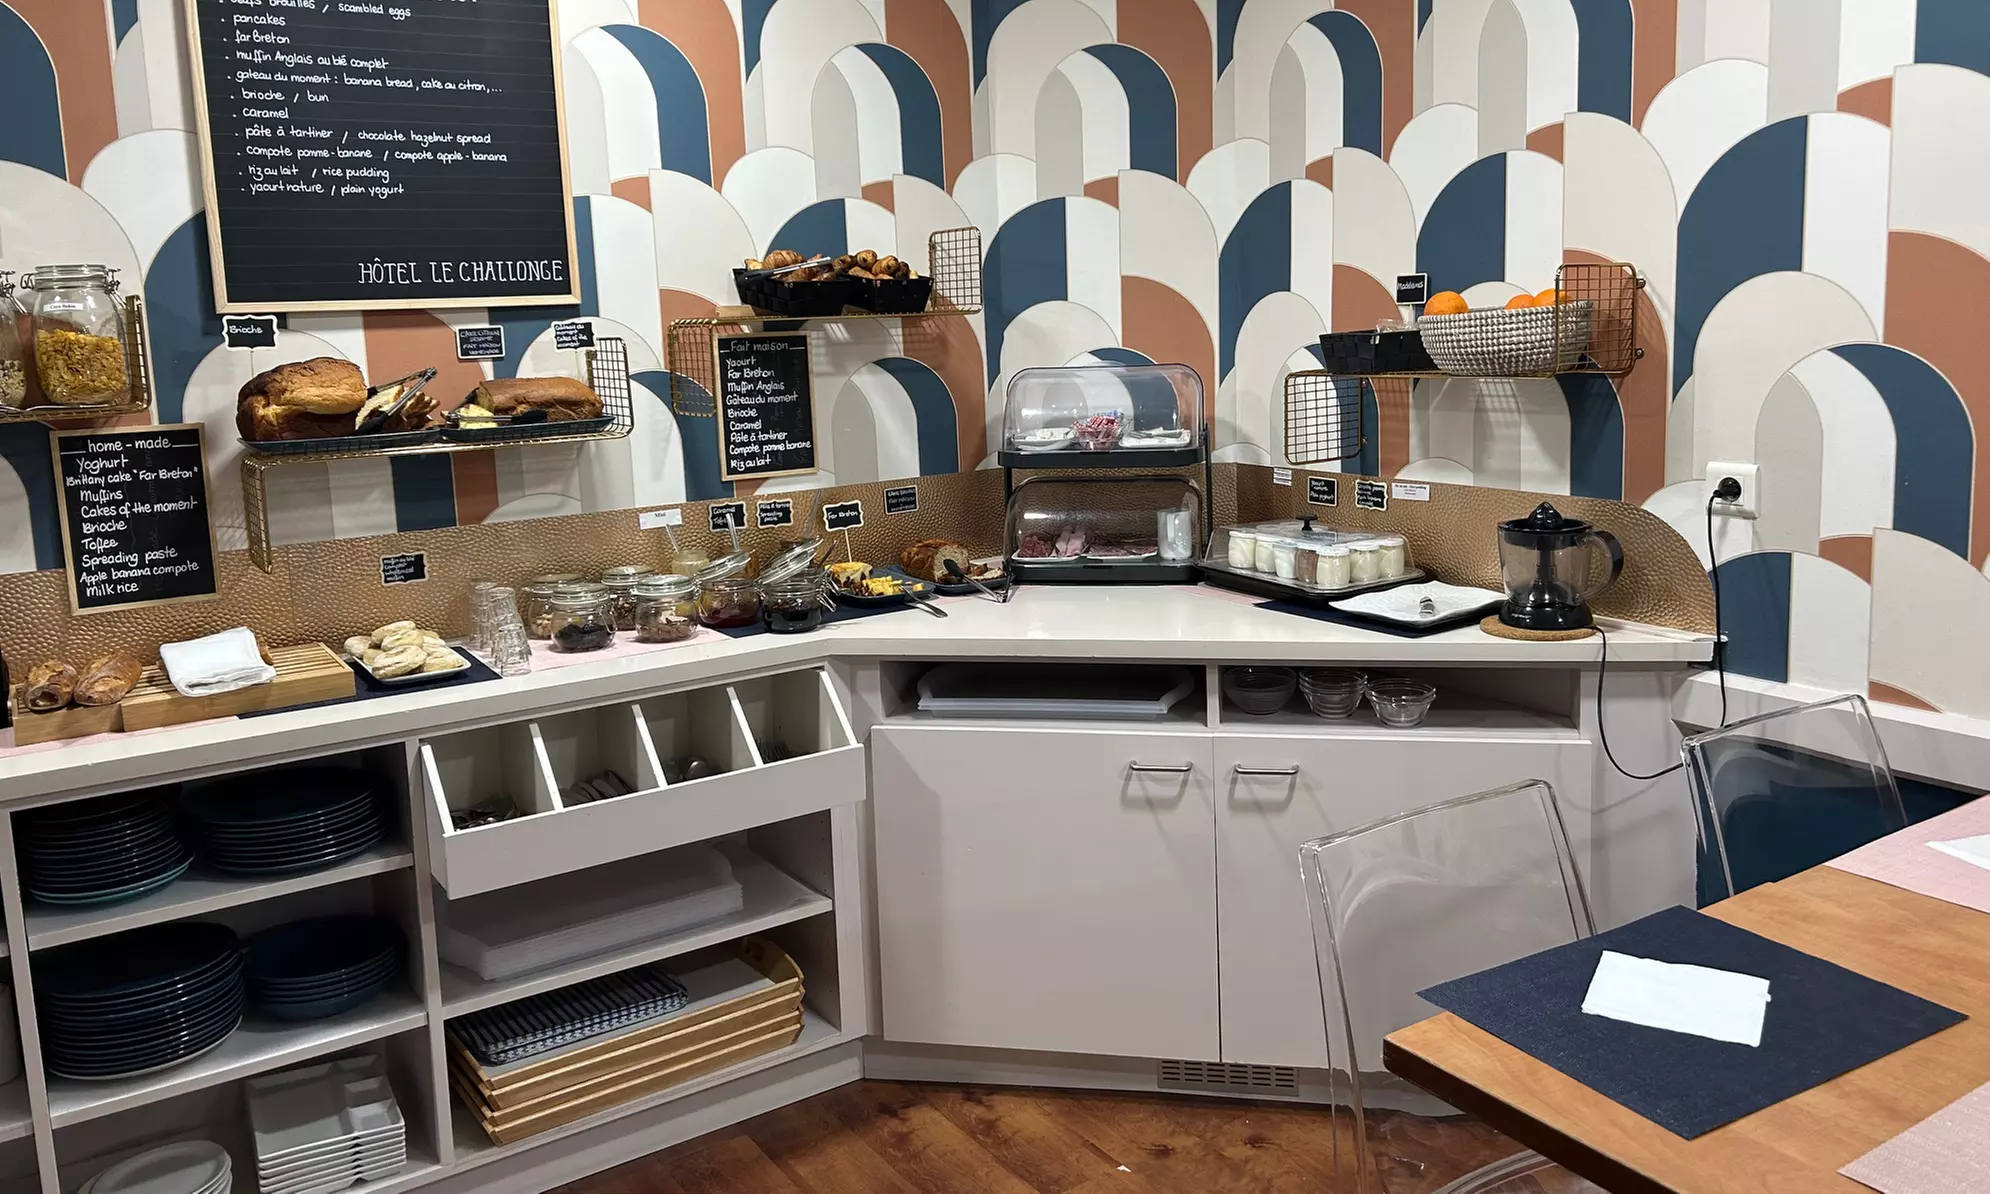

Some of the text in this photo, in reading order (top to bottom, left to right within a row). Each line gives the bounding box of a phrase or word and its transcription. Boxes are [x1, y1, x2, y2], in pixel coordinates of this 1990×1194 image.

[233, 12, 286, 26] pancakes
[338, 3, 384, 15] scambled
[388, 7, 412, 20] eggs
[235, 29, 290, 44] far Breton
[236, 49, 389, 72] muffin Anglais au blé complet
[235, 68, 272, 83] gateau
[274, 71, 288, 81] du
[290, 72, 331, 83] moment
[343, 73, 382, 87] banana
[421, 77, 443, 89] cake
[444, 82, 456, 90] au
[241, 87, 285, 100] brioche
[307, 90, 329, 102] bun
[242, 107, 289, 119] caramel
[245, 123, 272, 139] pâte
[289, 125, 333, 138] tartiner
[358, 129, 406, 142] chocolate
[410, 130, 453, 147] hazelnut
[456, 134, 491, 146] spread
[246, 145, 293, 160] compote
[394, 150, 434, 163] compote
[248, 164, 263, 180] riz
[280, 164, 299, 176] lait
[322, 167, 343, 176] rice
[346, 167, 390, 184] pudding
[249, 180, 285, 195] yaourt
[286, 180, 325, 193] nature
[341, 184, 365, 196] plain
[368, 184, 404, 199] yogurt
[358, 257, 563, 284] HÔTEL LE CHALLONGE
[229, 324, 263, 334] Brioche
[731, 341, 788, 352] Fait maison
[726, 355, 757, 369] Yaourt
[728, 367, 775, 379] Far Breton
[727, 380, 785, 394] Muffin Anglais
[726, 391, 798, 405] Gâteau du moment
[728, 407, 758, 418] Brioche
[729, 419, 762, 431] Caramel
[730, 431, 749, 442] Pâte
[757, 429, 788, 441] tartiner
[88, 439, 123, 453] home
[135, 436, 171, 449] made
[729, 440, 811, 456] Compote pomme banane
[76, 454, 129, 474] Yoghurt
[730, 459, 745, 471] Riz
[755, 453, 772, 466] lait
[66, 476, 105, 487] Brittany
[107, 471, 132, 483] cake
[80, 489, 123, 504] Muffins
[81, 496, 198, 518] Cakes of the moment
[82, 520, 127, 534] Brioche
[81, 537, 118, 554] Toffee
[81, 546, 178, 570] Spreading paste
[79, 560, 199, 586] Apple banana compote
[117, 582, 139, 593] rice
